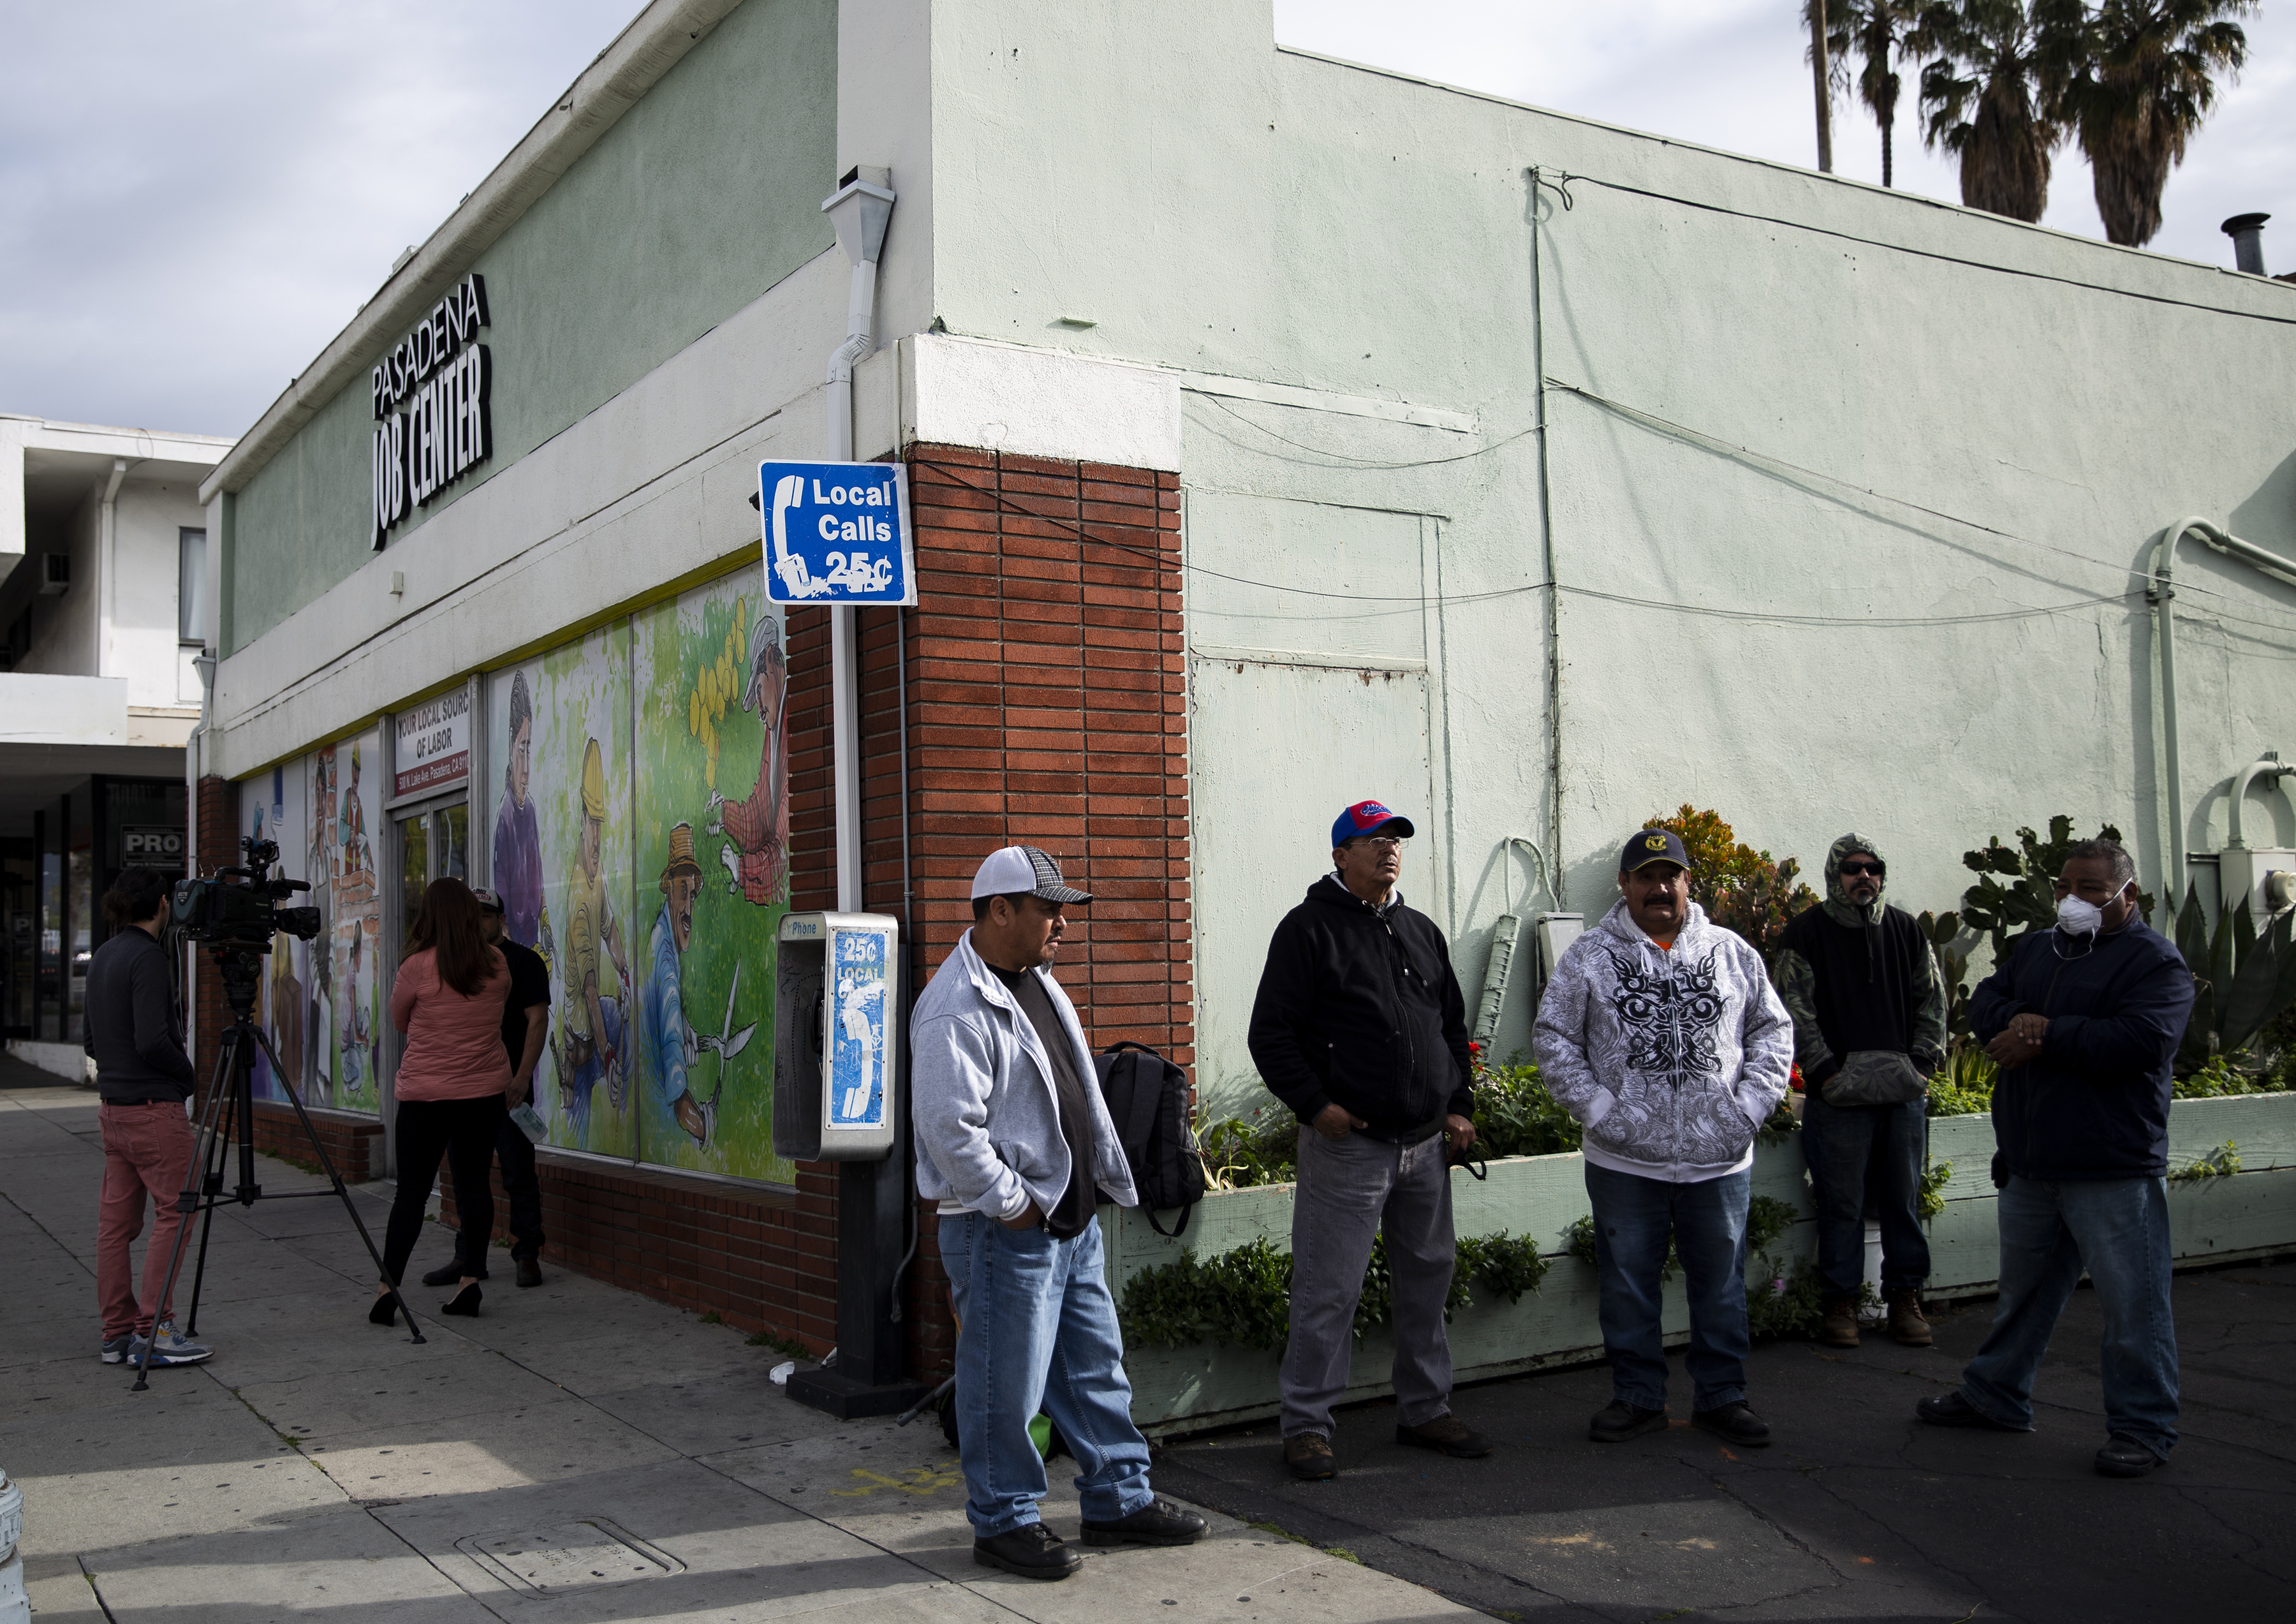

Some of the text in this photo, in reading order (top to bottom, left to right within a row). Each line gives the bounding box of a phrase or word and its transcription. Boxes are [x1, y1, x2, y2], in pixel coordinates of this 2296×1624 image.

[372, 273, 485, 420] PASADENA
[371, 343, 486, 550] JOB CENTER
[813, 479, 891, 506] Local
[818, 514, 891, 542] Calls
[826, 551, 893, 586] 25¢
[398, 691, 468, 739] YOUR LOCAL SOURC
[417, 727, 452, 758] OF LABOR
[411, 772, 421, 786] Lake
[452, 757, 459, 773] CA
[459, 754, 469, 771] 9110
[127, 834, 182, 852] PRO
[792, 921, 816, 935] Phone
[844, 937, 876, 964] 25¢
[837, 967, 881, 982] LOCAL
